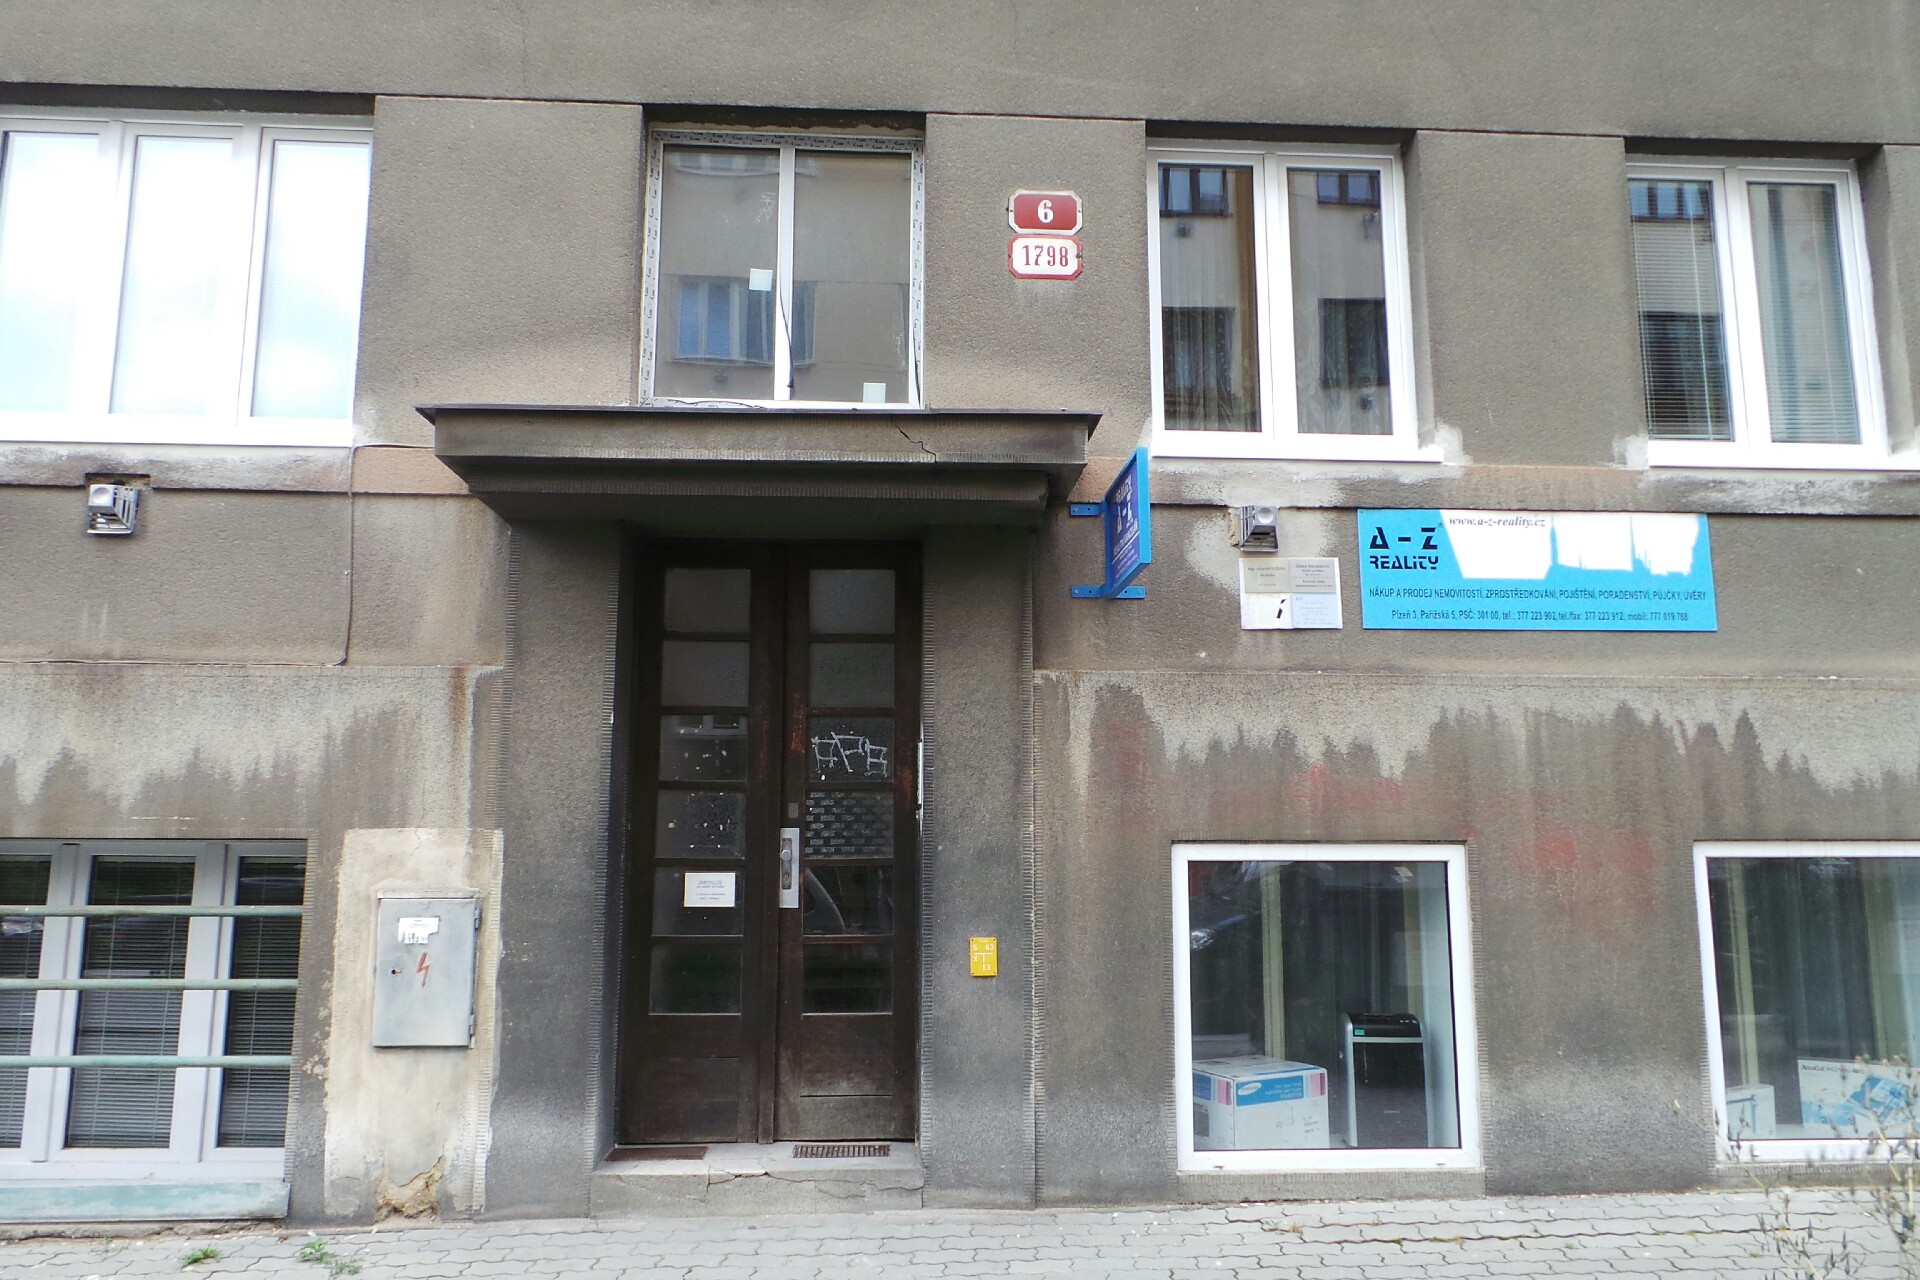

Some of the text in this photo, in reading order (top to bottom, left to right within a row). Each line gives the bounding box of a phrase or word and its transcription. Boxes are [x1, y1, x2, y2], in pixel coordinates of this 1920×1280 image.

[1037, 199, 1054, 223] 6
[1021, 244, 1069, 267] 1798
[1448, 515, 1547, 529] www.a-z-reality.cz
[1369, 586, 1395, 598] NÁKUP
[1396, 588, 1402, 598] A
[1403, 588, 1433, 599] PRODEJ
[1684, 589, 1707, 601] ÚVĚRY
[1391, 609, 1411, 620] Plzeň
[1420, 609, 1450, 620] Pařížská
[1477, 611, 1490, 620] 301
[1517, 611, 1529, 621] 377
[1530, 611, 1543, 621] 223
[1584, 611, 1596, 621] 377
[1597, 612, 1610, 621] 223
[1650, 612, 1662, 622] 777
